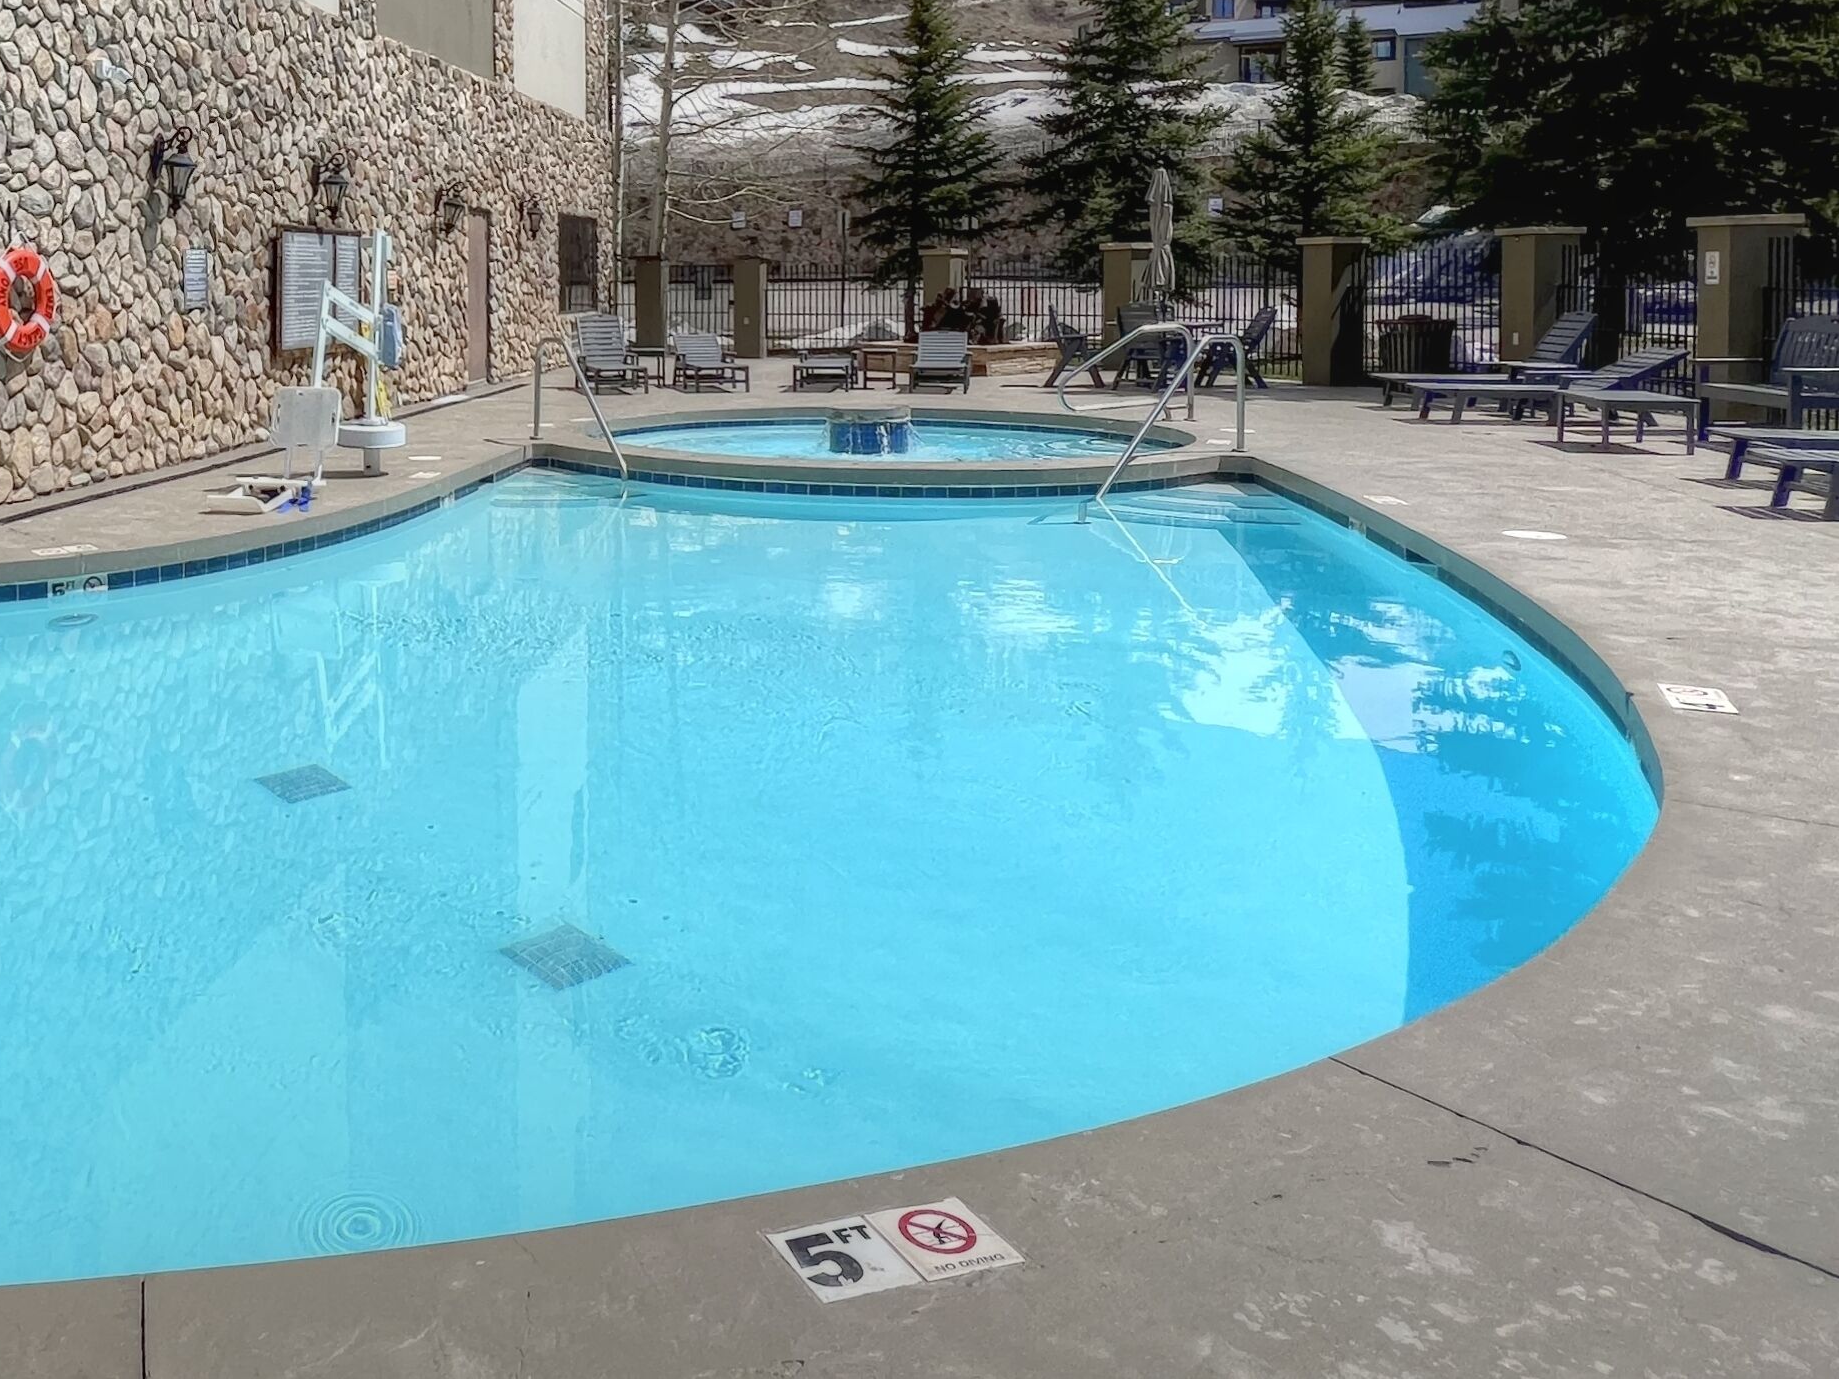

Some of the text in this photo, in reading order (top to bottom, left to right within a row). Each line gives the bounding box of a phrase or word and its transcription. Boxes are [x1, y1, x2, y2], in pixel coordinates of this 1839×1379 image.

[52, 582, 66, 596] 5
[784, 1224, 872, 1287] 5 FT
[934, 1253, 1006, 1273] NO DIVING
